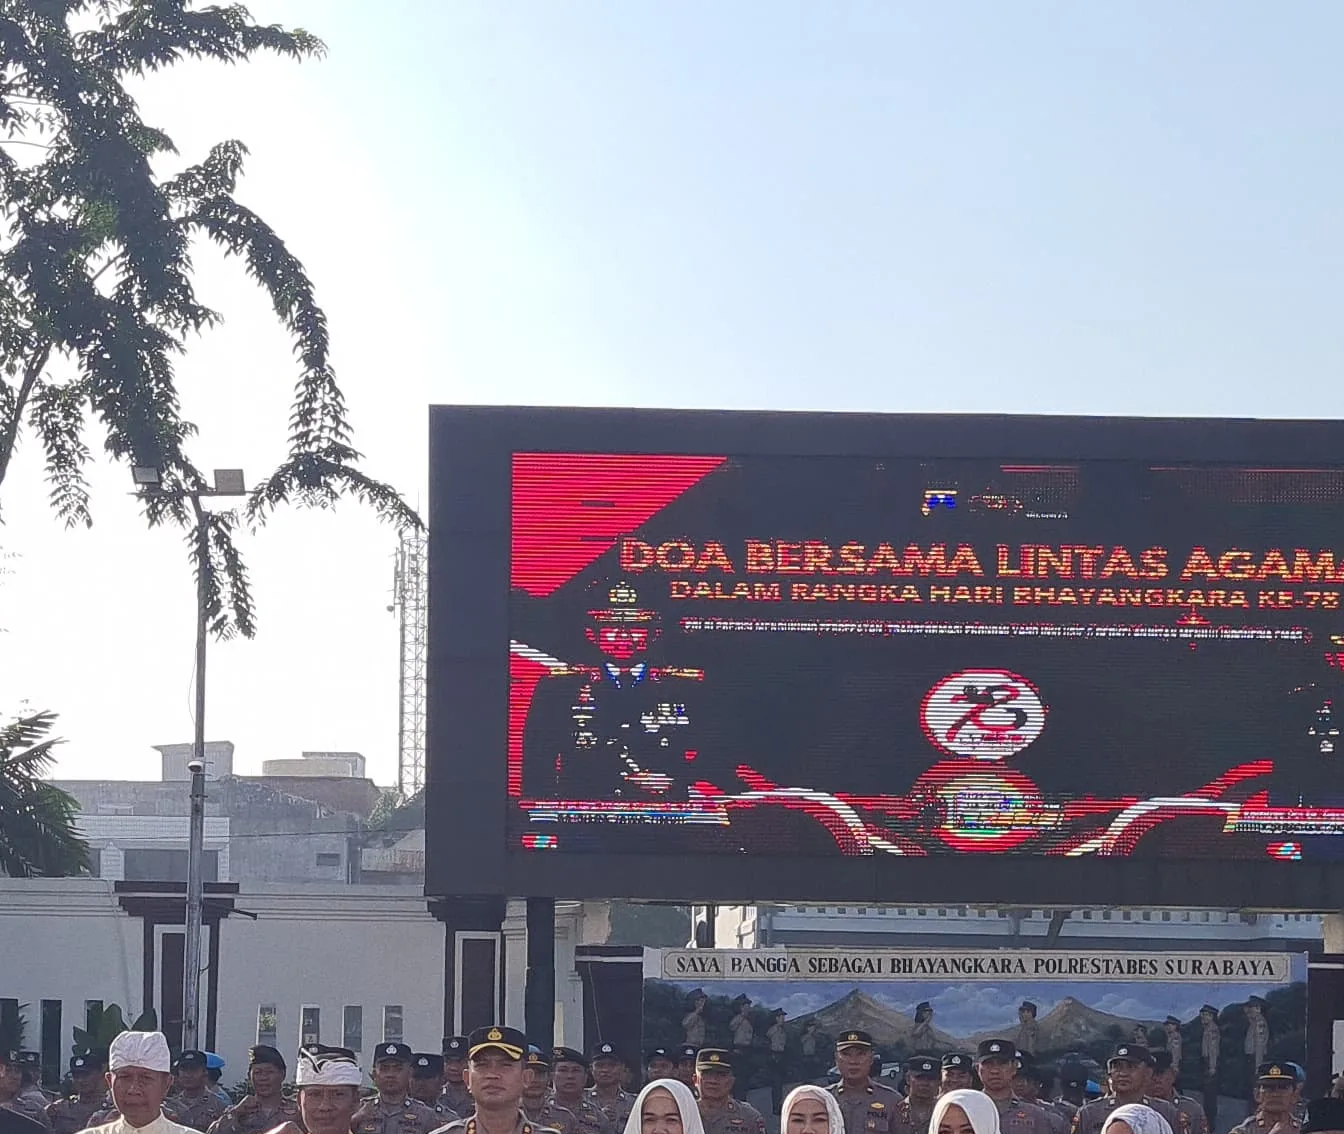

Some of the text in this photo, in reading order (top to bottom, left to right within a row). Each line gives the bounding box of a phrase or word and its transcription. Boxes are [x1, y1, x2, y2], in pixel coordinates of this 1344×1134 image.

[619, 536, 735, 573] DOA
[744, 538, 985, 578] BERSAMA
[996, 543, 1169, 580] LINTAS
[668, 580, 783, 601] DALAM
[791, 582, 924, 603] RANGKA
[930, 585, 1003, 605] HARI
[1013, 586, 1250, 608] BHAYANGKARA
[676, 956, 1275, 977] SAYA BANGGA SEBAGAI BHAYANGKARA POLRESTABES SURABAYA
